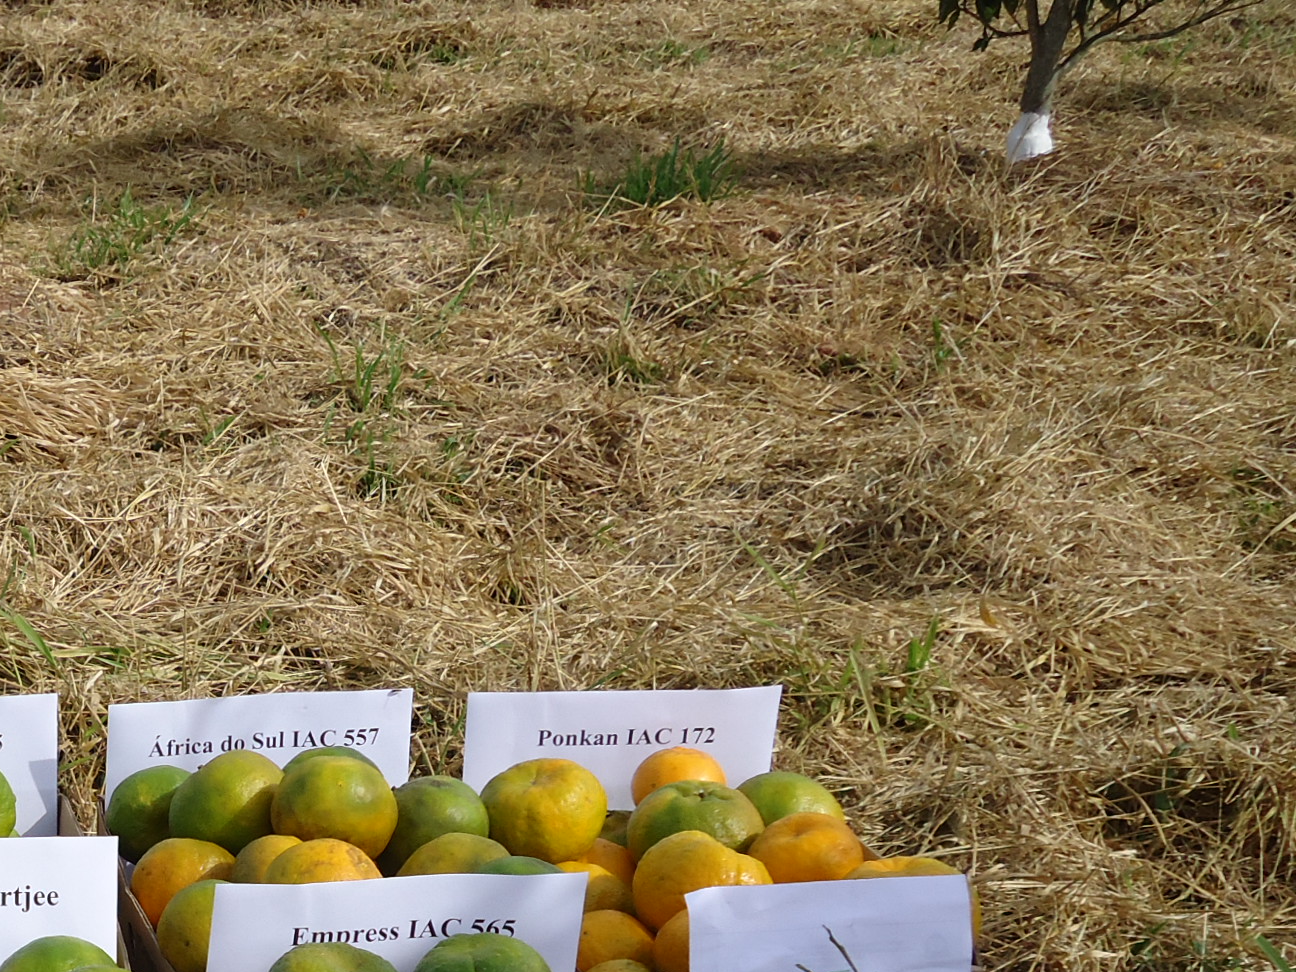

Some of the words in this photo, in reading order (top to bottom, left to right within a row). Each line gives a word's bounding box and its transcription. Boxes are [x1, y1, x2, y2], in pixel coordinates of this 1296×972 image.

[148, 735, 213, 757] África
[221, 735, 245, 752] do
[253, 731, 284, 749] Sul
[293, 730, 336, 748] IAC
[343, 728, 380, 746] 557
[537, 728, 618, 747] Ponkan
[626, 728, 672, 745] IAC
[679, 727, 716, 744] 172
[408, 918, 462, 939] IAC
